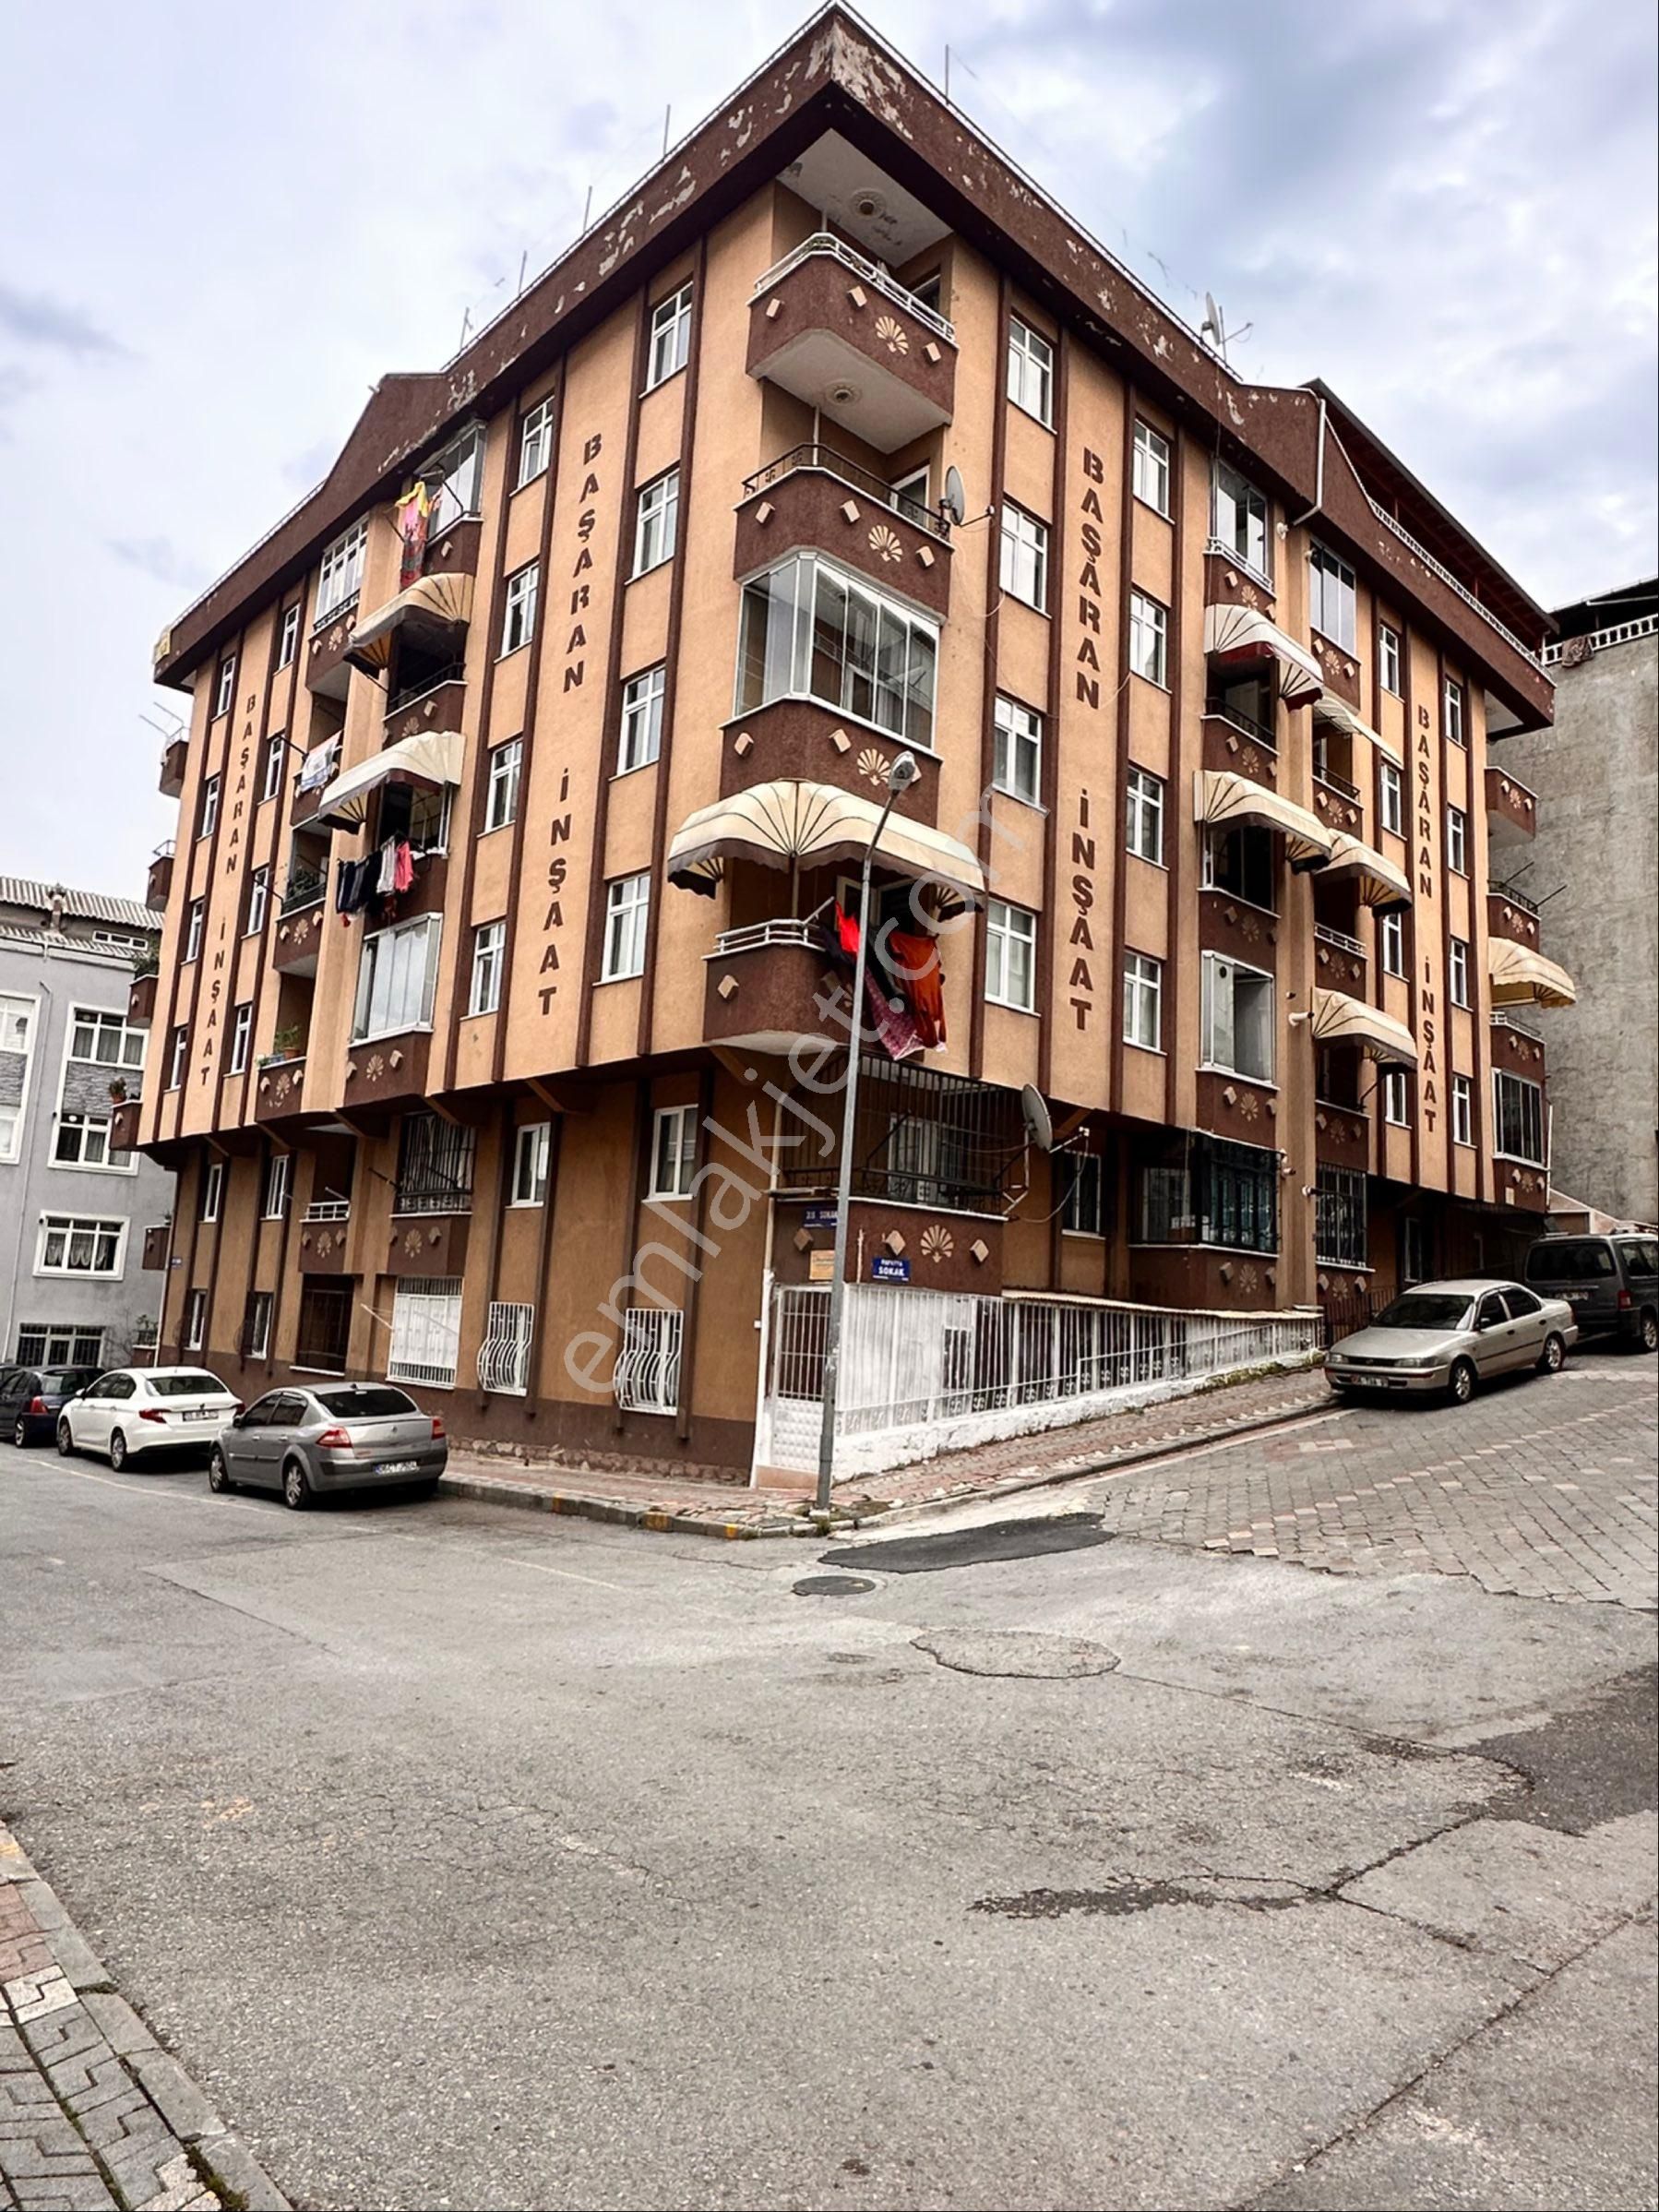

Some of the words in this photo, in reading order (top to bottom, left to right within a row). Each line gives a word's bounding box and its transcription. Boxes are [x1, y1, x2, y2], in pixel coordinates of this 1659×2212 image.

[563, 432, 603, 694] BAŞARAN
[1076, 445, 1104, 711] BAŞARAN
[225, 693, 257, 876] BAŞARAN
[1416, 704, 1432, 900] BAŞARAN
[538, 767, 571, 1016] İNŞAAT
[1068, 787, 1095, 1032] İNŞAAT
[200, 916, 227, 1087] İNŞAAT
[1422, 955, 1438, 1133] İNŞAAT
[877, 1265, 906, 1277] SOKAK
